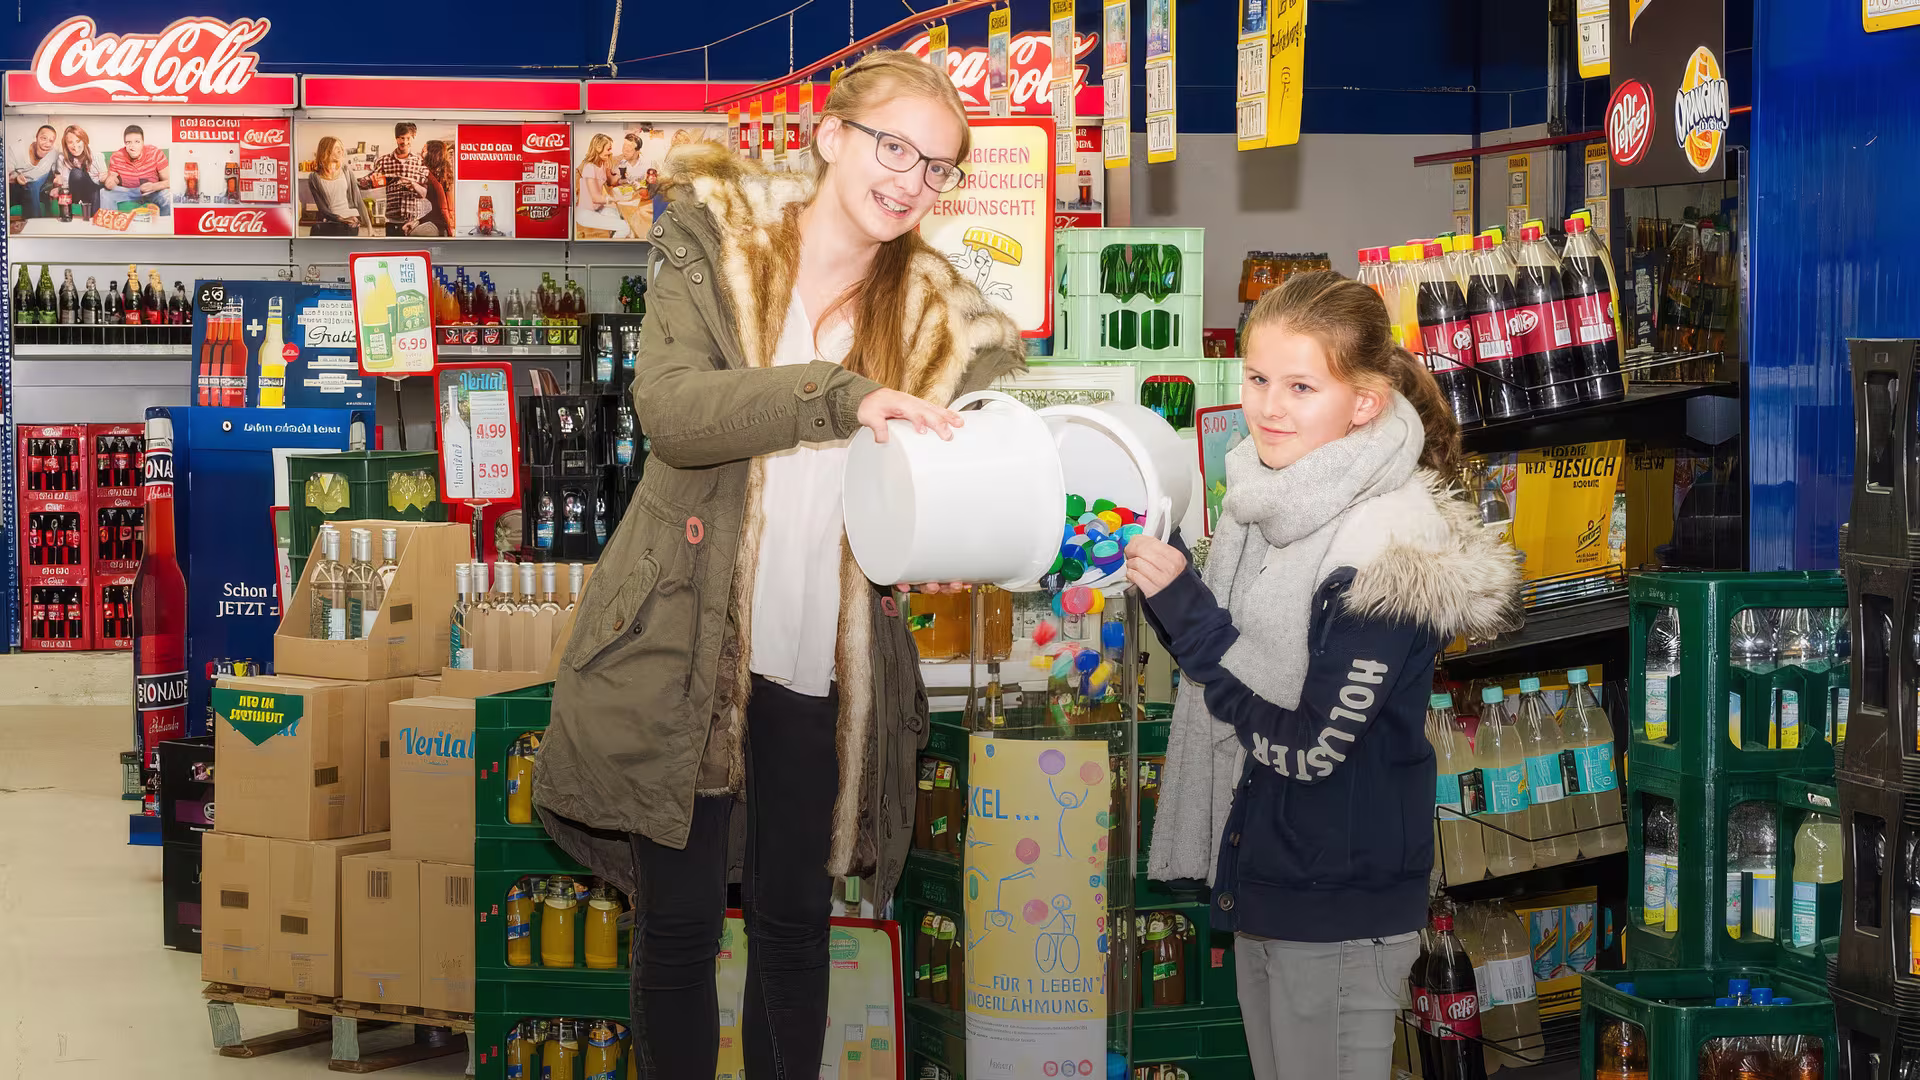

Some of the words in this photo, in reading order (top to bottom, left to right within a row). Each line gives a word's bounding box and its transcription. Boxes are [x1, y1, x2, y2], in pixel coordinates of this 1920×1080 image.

[933, 196, 1035, 216] ERWÜNSCHT!
[1553, 456, 1616, 479] BESUCH
[223, 582, 268, 598] Schon
[216, 600, 266, 618] JETZT
